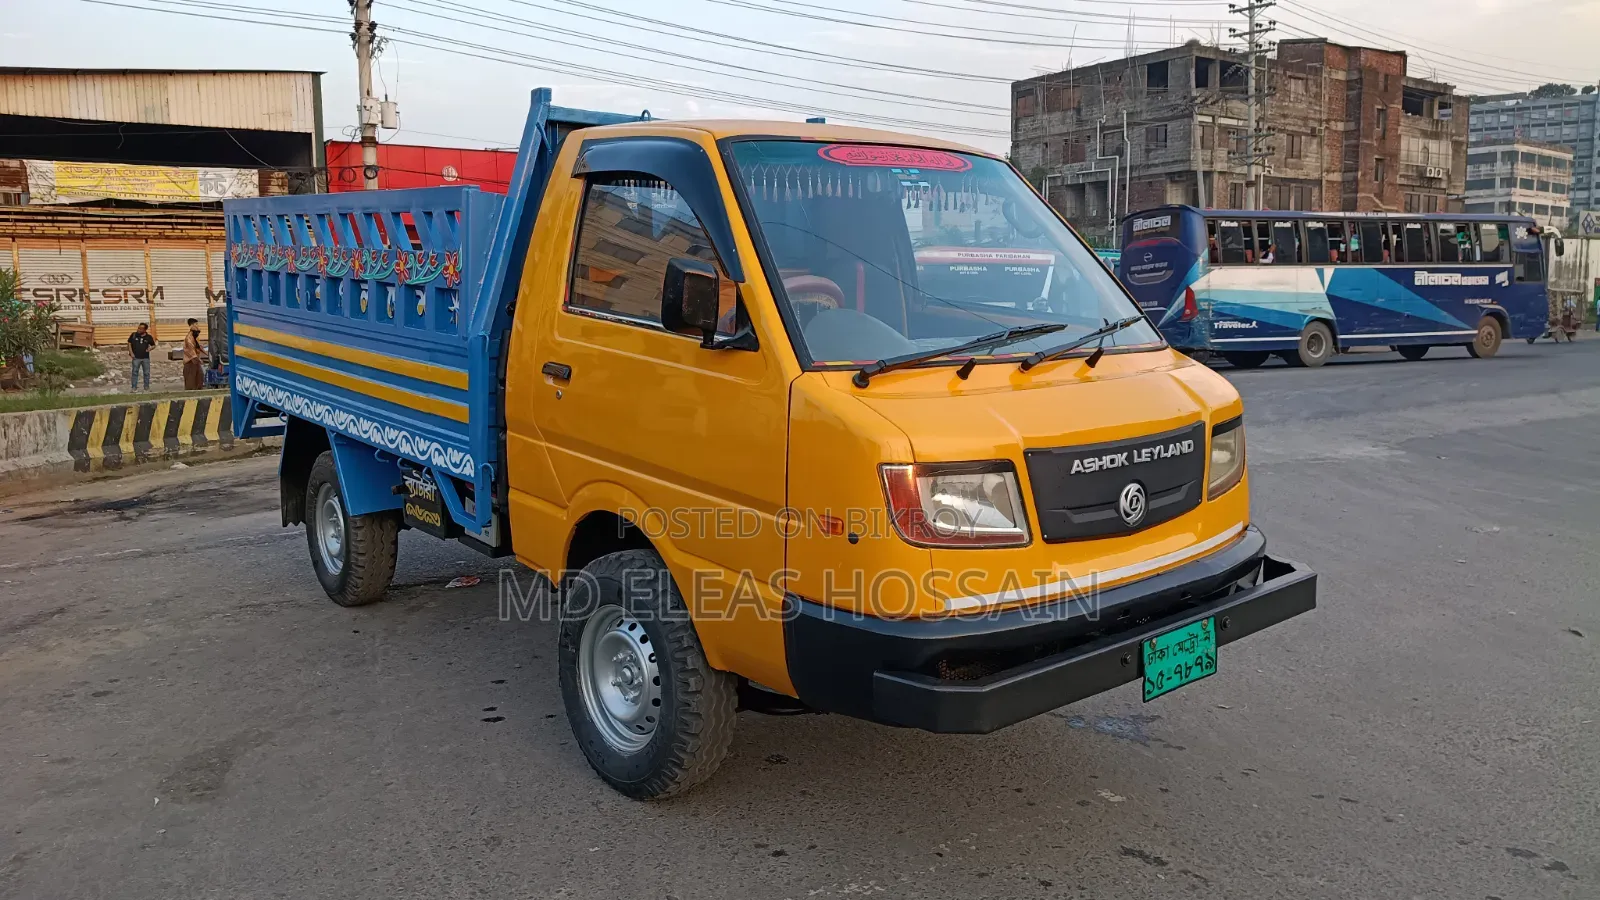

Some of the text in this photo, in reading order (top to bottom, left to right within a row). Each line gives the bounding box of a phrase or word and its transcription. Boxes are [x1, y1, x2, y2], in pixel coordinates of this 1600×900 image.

[1070, 440, 1194, 475] ASHOK LEYLAND
[1147, 645, 1170, 666] ঢাকা
